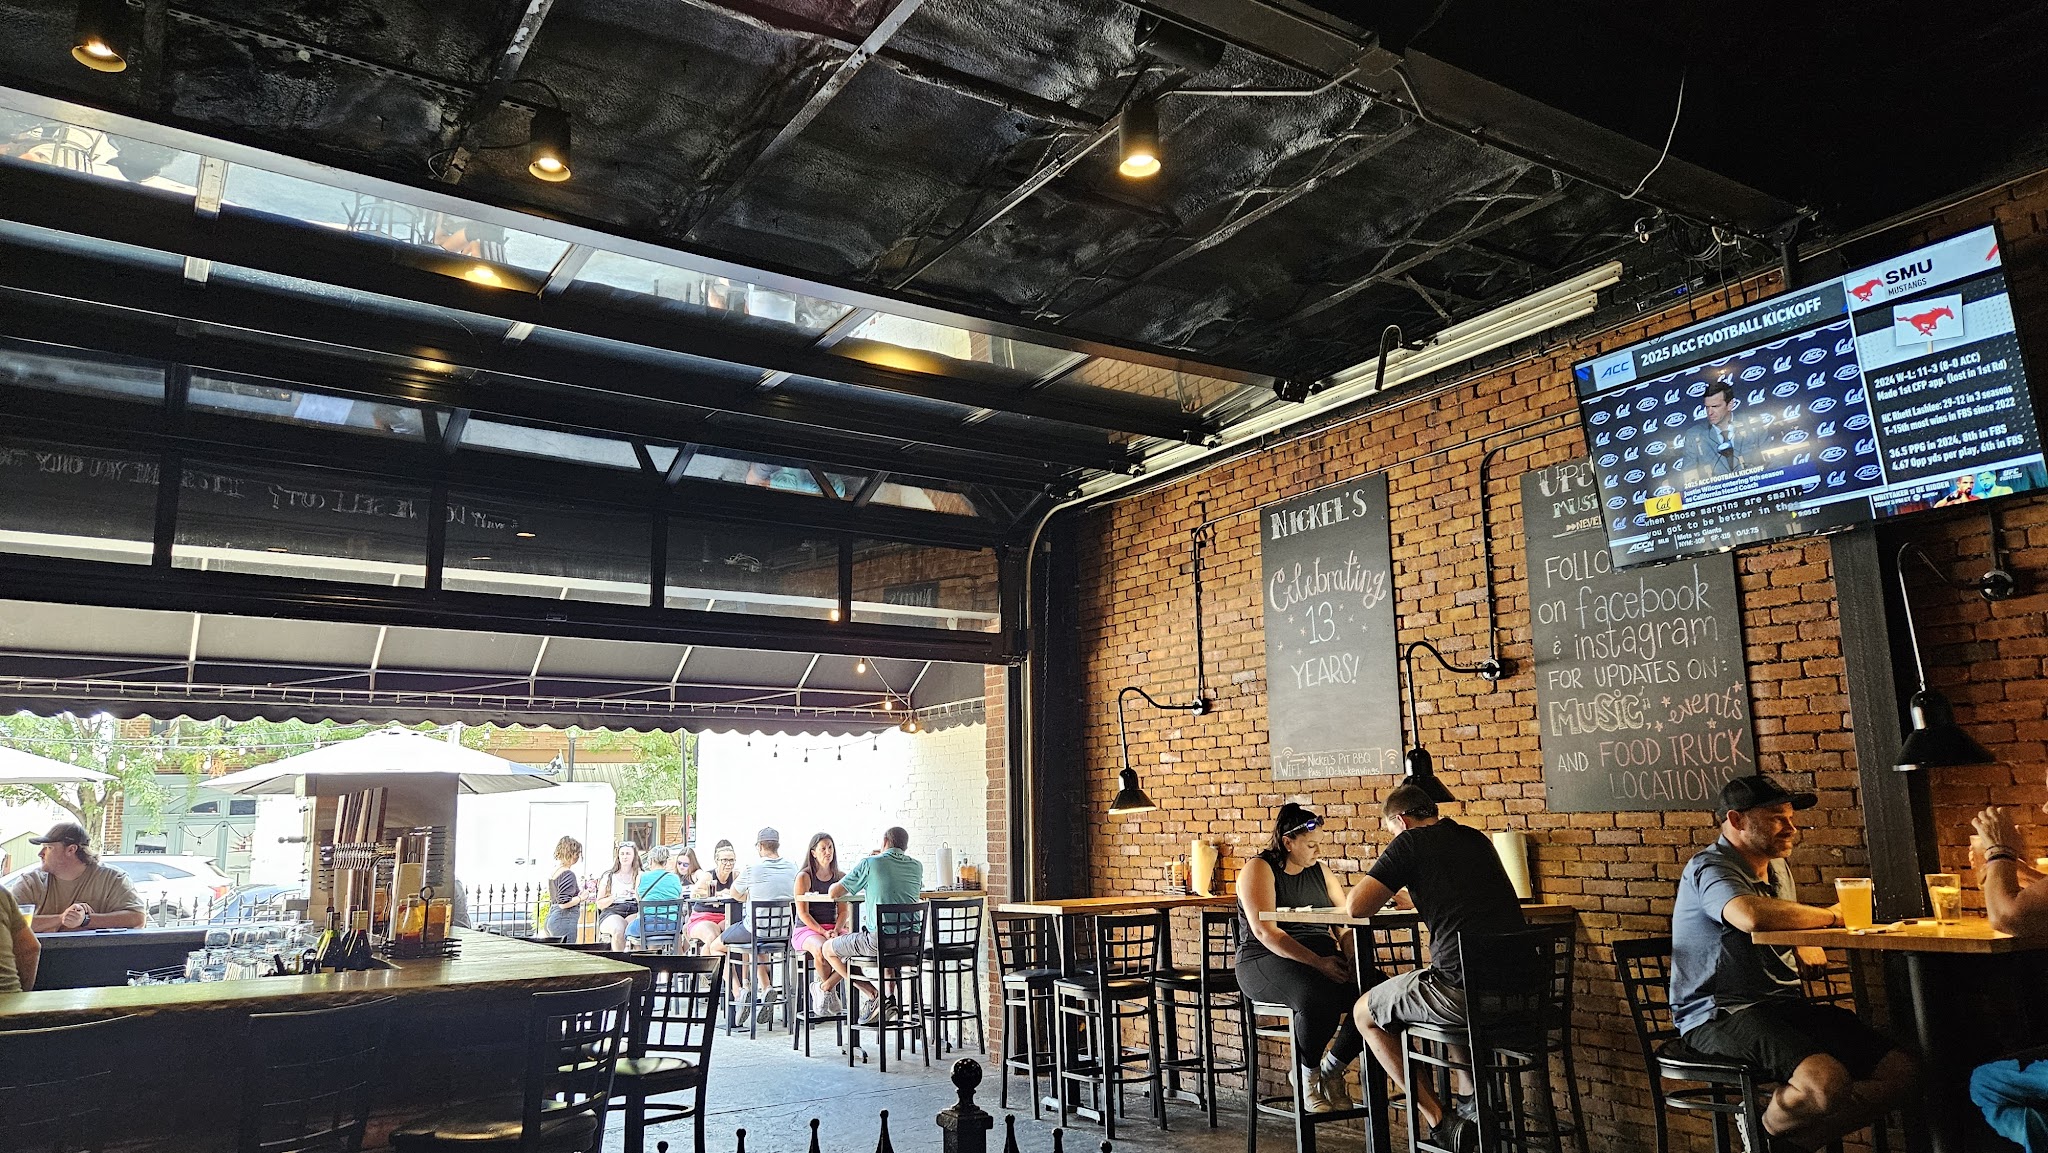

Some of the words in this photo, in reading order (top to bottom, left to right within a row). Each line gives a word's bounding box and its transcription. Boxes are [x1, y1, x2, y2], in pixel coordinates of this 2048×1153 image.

[1886, 258, 1933, 284] SMU
[1888, 278, 1927, 296] MUSTANGS
[1640, 346, 1670, 366] 2025
[1671, 339, 1696, 358] ACC
[1697, 316, 1762, 350] FOOTBALL
[1762, 296, 1822, 328] KICKOFF
[1835, 338, 1854, 356] Cal
[1600, 360, 1630, 379] ACC
[1774, 356, 1792, 374] Cal
[1874, 376, 1895, 388] 2024
[1896, 371, 1916, 384] W-L:
[1918, 363, 1938, 377] 11-3
[1960, 352, 1980, 366] ACC)
[1807, 372, 1826, 390] Cal
[1877, 388, 1898, 400] Made
[1898, 385, 1912, 396] 1st
[1912, 380, 1927, 392] CFP
[1928, 378, 1946, 390] app.
[1946, 372, 1967, 385] (lost
[1968, 369, 1976, 379] in
[1976, 364, 1991, 376] 1st
[1992, 358, 2008, 372] Rd)
[1665, 389, 1680, 405] Cal
[1748, 388, 1765, 406] Cal
[1845, 388, 1864, 406] Cal
[1882, 414, 1892, 424] HC
[1892, 407, 1912, 421] Rhett
[1912, 401, 1942, 417] Lashlee:
[1943, 396, 1966, 410] 29-12
[1966, 394, 1974, 402] in
[1975, 392, 1981, 401] 3
[1982, 384, 2013, 400] seasons
[1616, 403, 1630, 419] Cal
[1783, 404, 1800, 420] Cal
[1884, 422, 1910, 436] T-15th
[1910, 418, 1929, 430] most
[1930, 415, 1948, 427] wins
[1948, 413, 1956, 422] in
[1957, 407, 1972, 420] FBS
[1974, 404, 1994, 416] since
[1995, 397, 2016, 410] 2022
[1643, 418, 1658, 434] Cal
[1817, 421, 1836, 438] Cal
[1596, 432, 1610, 447] Cal
[1855, 438, 1875, 455] Cal
[1889, 446, 1908, 458] 36.5
[1908, 442, 1926, 454] PPG
[1926, 440, 1936, 450] in
[1936, 435, 1962, 448] 2024,
[1962, 430, 1978, 442] 8th
[1979, 428, 1988, 438] in
[1989, 424, 2008, 436] FBS
[1625, 447, 1639, 462] Cal
[1892, 458, 1909, 470] 4.67
[1910, 456, 1927, 468] Opp
[1928, 452, 1942, 465] yds
[1943, 451, 1958, 462] per
[1959, 446, 1979, 458] play,
[1980, 442, 1996, 454] 6th
[1997, 440, 2006, 449] in
[2007, 434, 2024, 447] FBS
[1652, 463, 1666, 478] Cal
[1684, 479, 1698, 489] 2025
[1710, 471, 1739, 484] FOOTBALL
[1739, 466, 1764, 479] KICKOFF
[1827, 471, 1846, 487] Cal
[2003, 468, 2019, 476] UFC
[1684, 488, 1701, 498] Justin
[1702, 484, 1720, 494] Wilcox
[1720, 479, 1748, 491] entering
[1749, 476, 1760, 484] 9th
[1760, 470, 1784, 481] season
[1692, 490, 1720, 502] California
[1721, 486, 1738, 496] Head
[1739, 482, 1758, 492] Coach
[1873, 488, 1909, 502] WHITTAKER
[1926, 481, 1950, 492] RIDDER
[1270, 488, 1367, 540] NICKEL'S
[1656, 498, 1671, 512] Cal
[1669, 509, 1696, 521] those
[1700, 502, 1739, 515] margins
[1744, 497, 1762, 505] are
[1767, 487, 1802, 502] small,
[1666, 523, 1682, 535] got
[1687, 521, 1698, 529] to
[1703, 516, 1714, 526] be
[1719, 510, 1752, 522] better
[1759, 506, 1770, 514] in
[1702, 527, 1722, 536] Giants
[1627, 540, 1654, 554] ACCN
[1270, 550, 1386, 612] Celebrating
[1538, 600, 1566, 624] on
[1576, 563, 1712, 630] facebook
[1306, 601, 1336, 644] 13
[1553, 635, 1561, 660] &
[1574, 616, 1718, 660] instagram
[1290, 653, 1359, 690] YEARS!
[1548, 668, 1583, 690] FOR
[1594, 660, 1680, 687] UPDATES
[1687, 657, 1728, 680] ON:
[1668, 686, 1743, 724] events
[1353, 752, 1372, 764] BBQ
[1558, 752, 1589, 772] AND
[1600, 738, 1660, 768] FOOD
[1668, 728, 1751, 766] TRUCK
